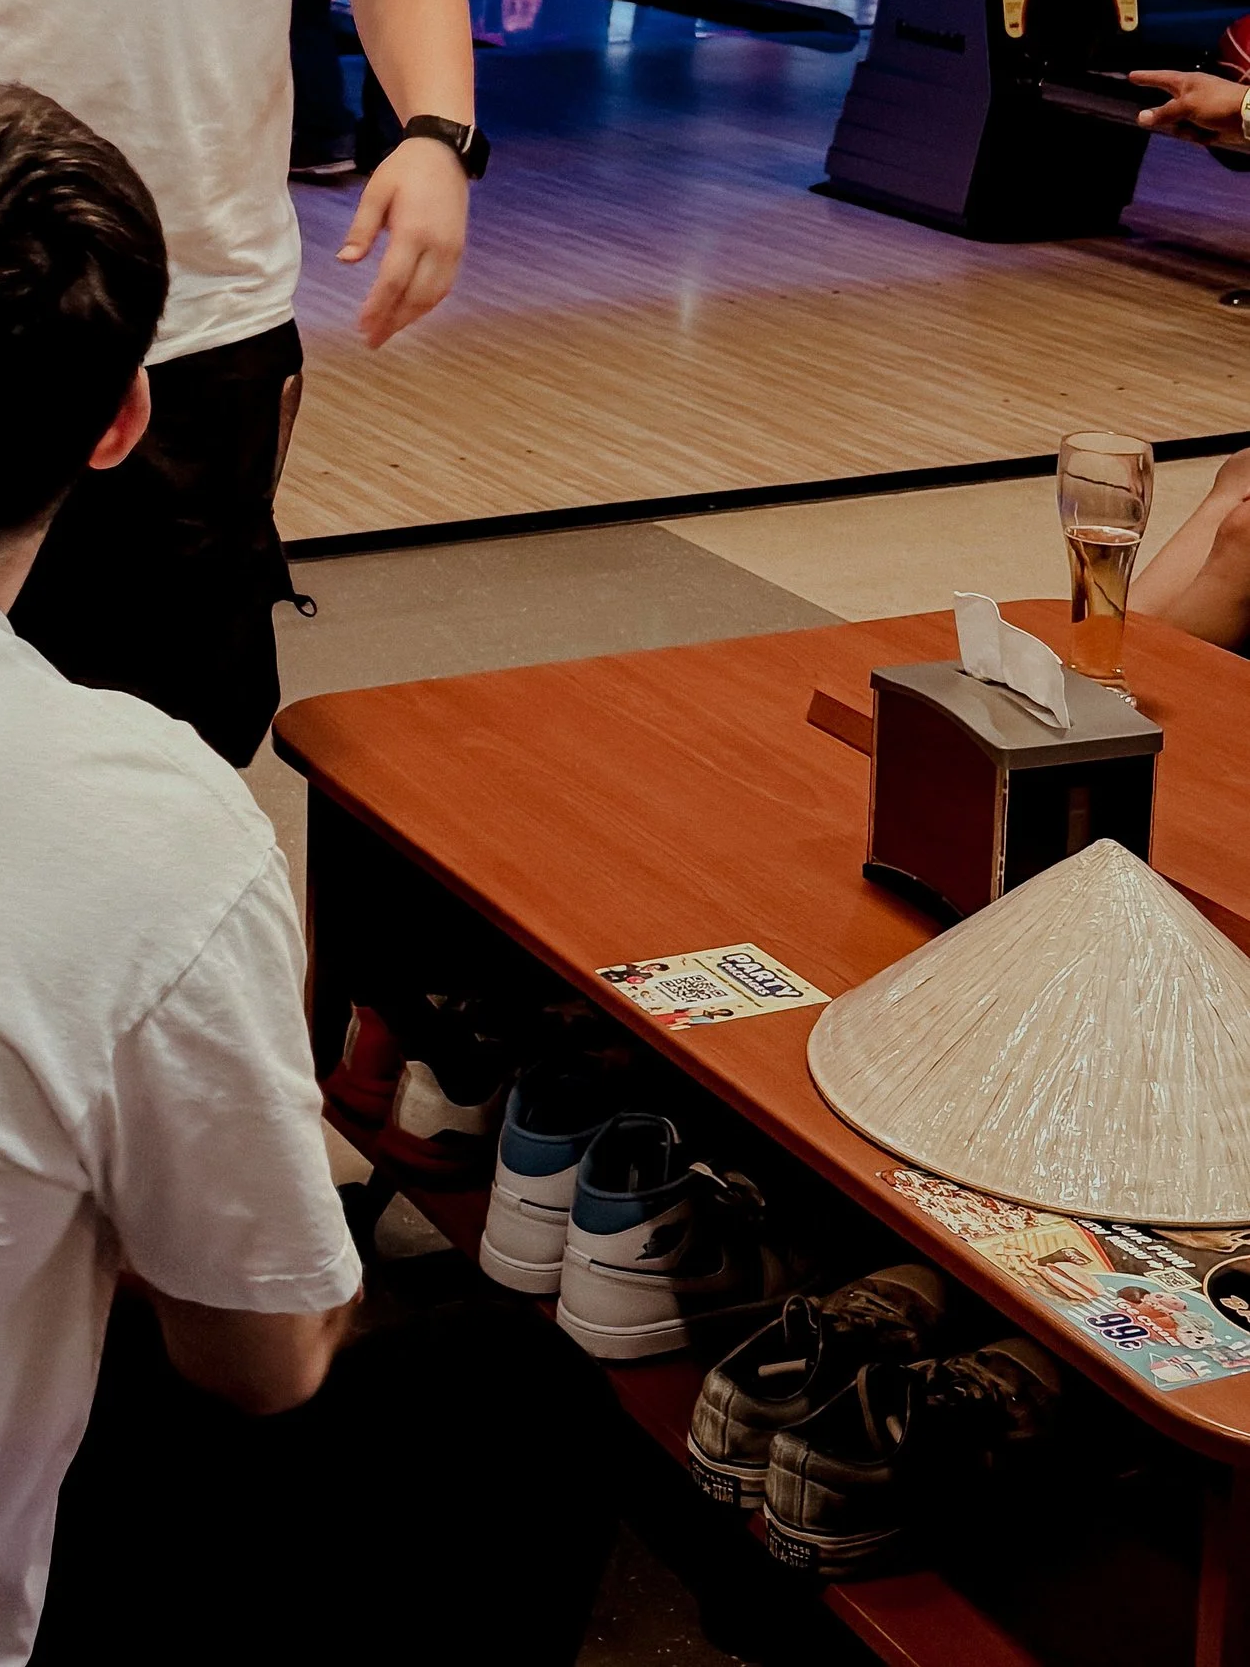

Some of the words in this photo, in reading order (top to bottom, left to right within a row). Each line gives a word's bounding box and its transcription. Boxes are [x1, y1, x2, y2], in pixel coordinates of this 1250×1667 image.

[722, 963, 771, 996] PACKAGES
[723, 953, 802, 997] PARTY
[1105, 1235, 1152, 1260] MENU
[1111, 1224, 1152, 1244] OUR
